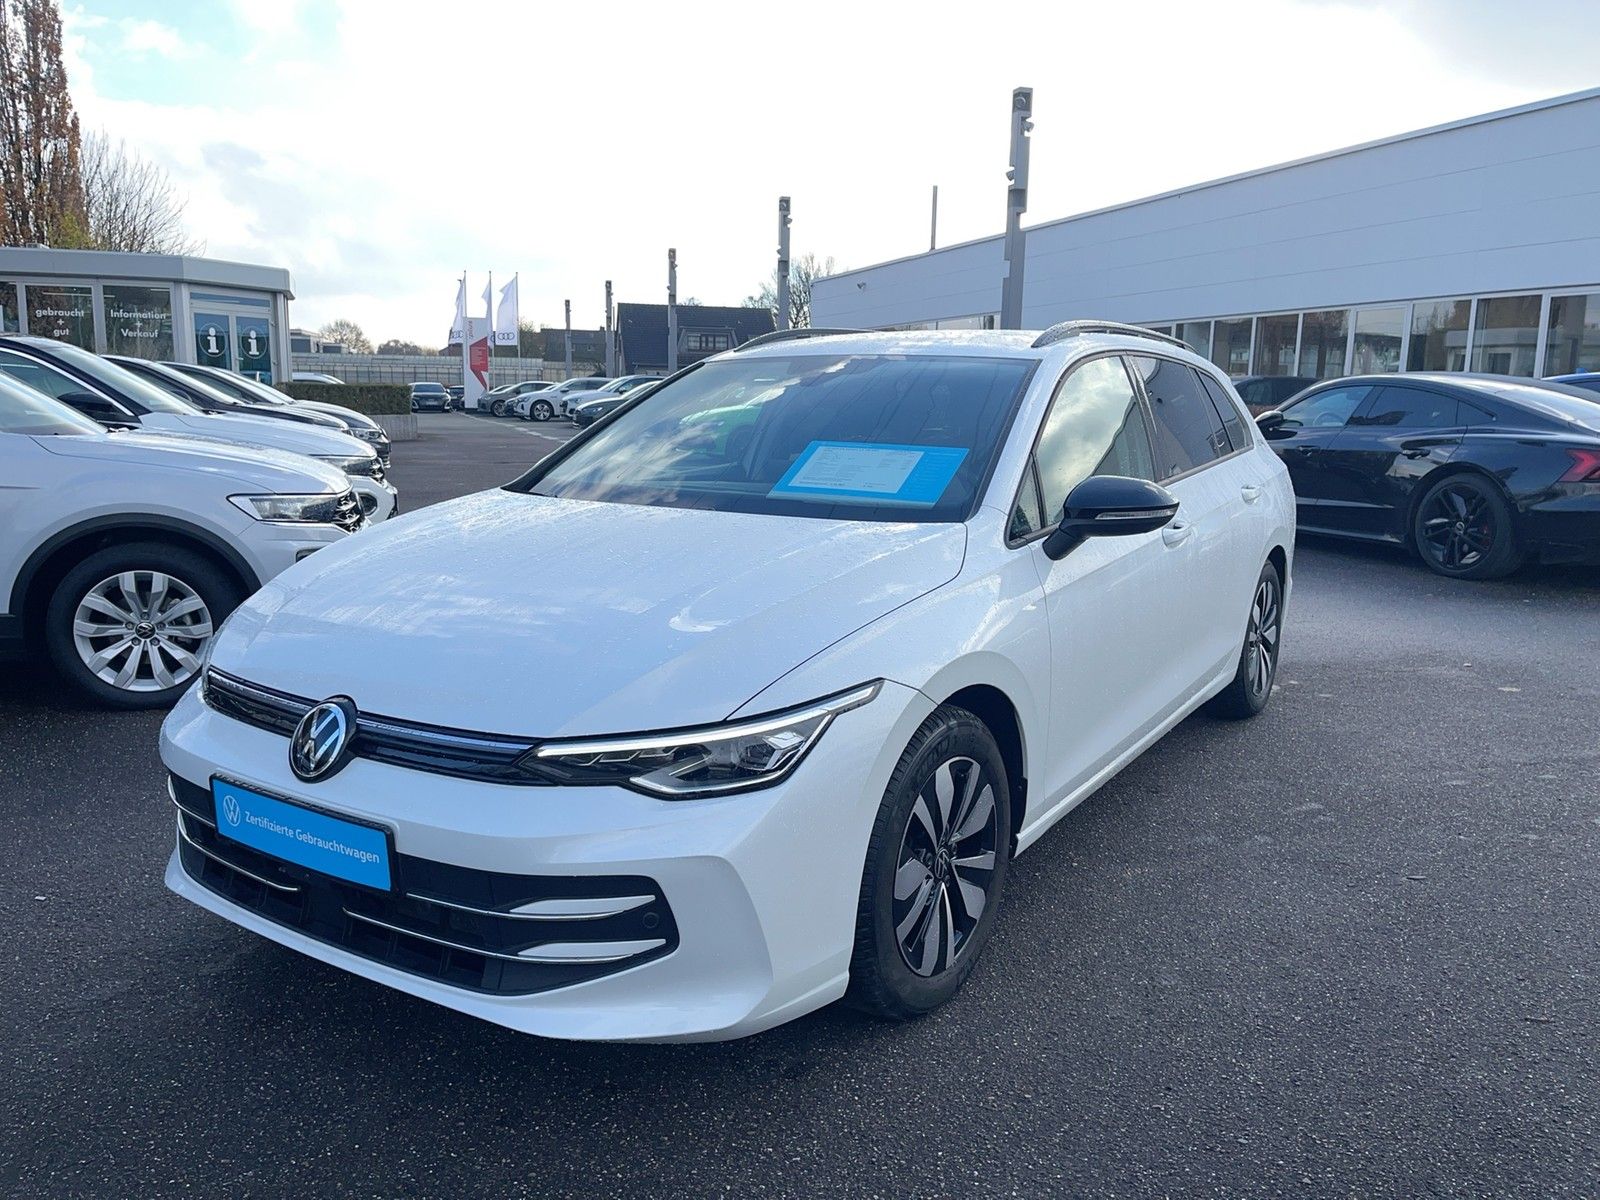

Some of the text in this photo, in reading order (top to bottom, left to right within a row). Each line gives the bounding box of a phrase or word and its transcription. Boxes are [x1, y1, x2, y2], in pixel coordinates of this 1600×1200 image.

[35, 307, 85, 318] gebraucht
[110, 309, 166, 320] Information
[53, 328, 70, 338] gut
[120, 328, 159, 339] Verkauf
[244, 811, 380, 864] Zertifizierte Gebrauchtwagen
